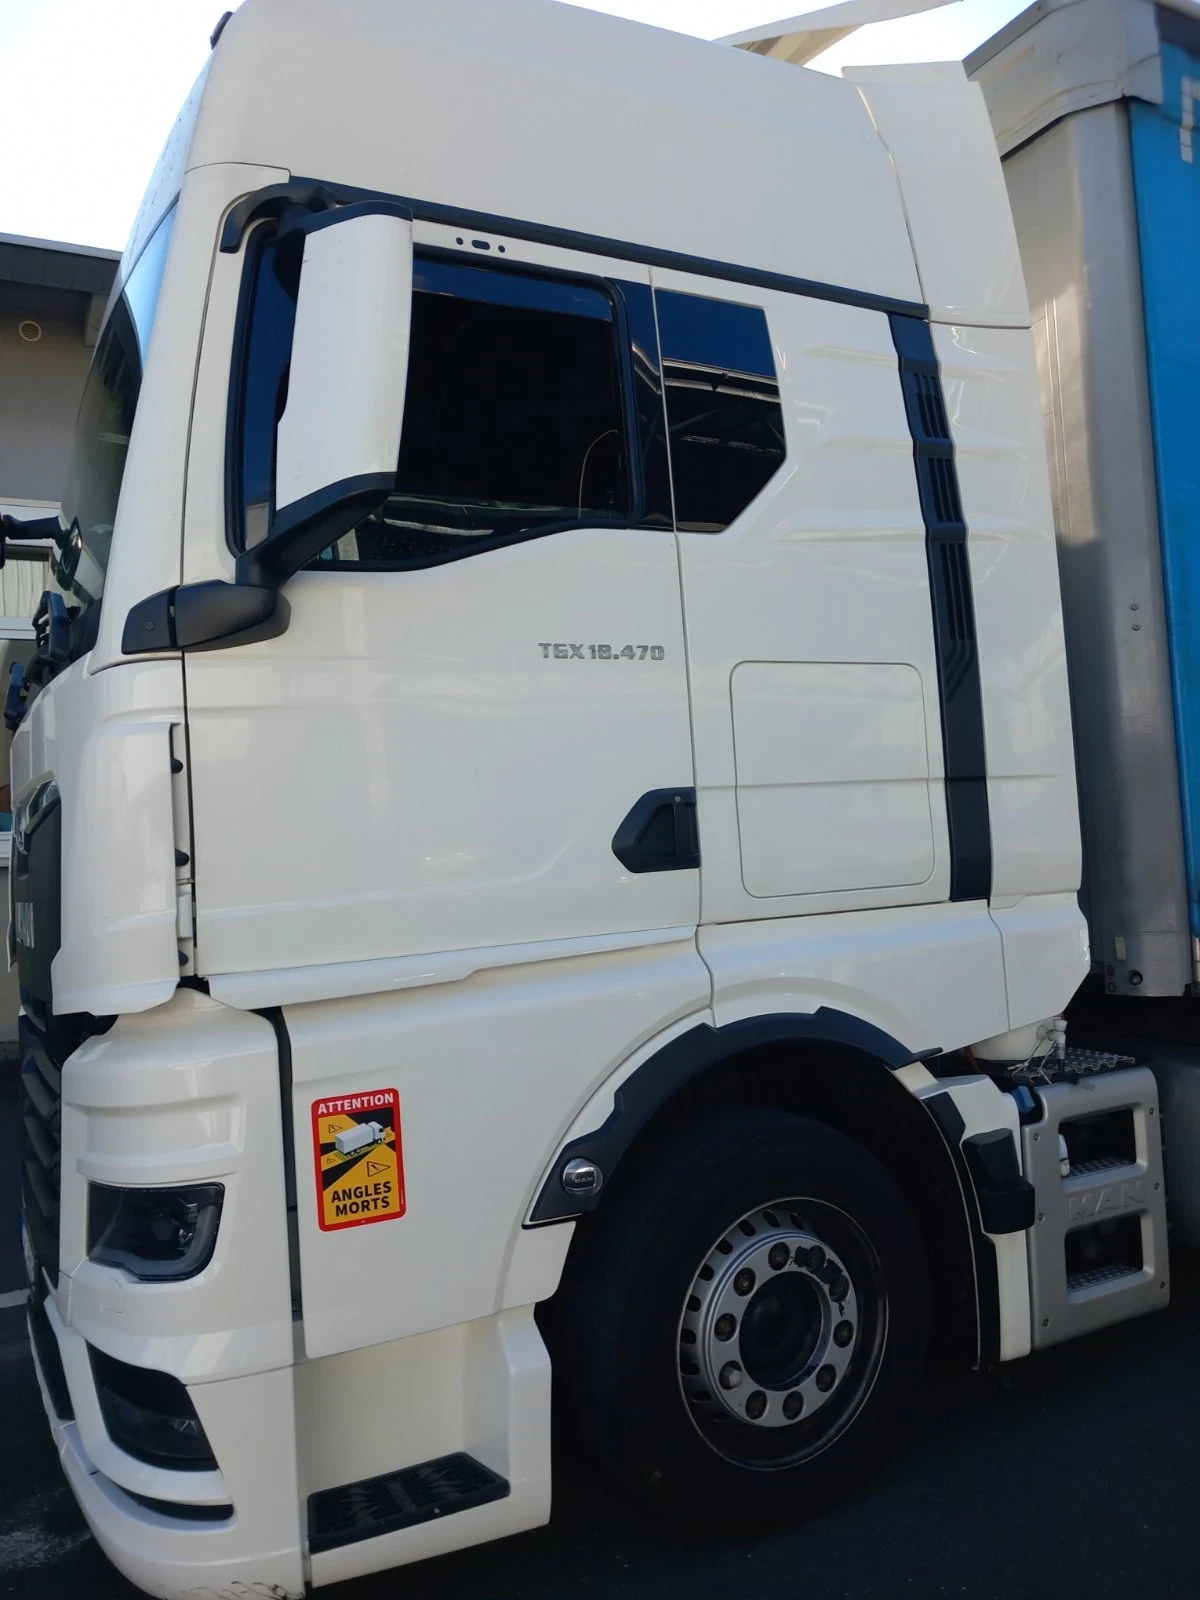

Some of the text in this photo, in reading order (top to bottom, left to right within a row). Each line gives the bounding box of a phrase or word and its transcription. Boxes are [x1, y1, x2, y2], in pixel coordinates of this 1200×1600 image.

[538, 642, 665, 661] TGX 18.470
[317, 1092, 394, 1115] ATTENTION
[331, 1180, 392, 1203] ANGLES
[1068, 1180, 1145, 1221] MAN
[335, 1196, 390, 1217] MORTS
